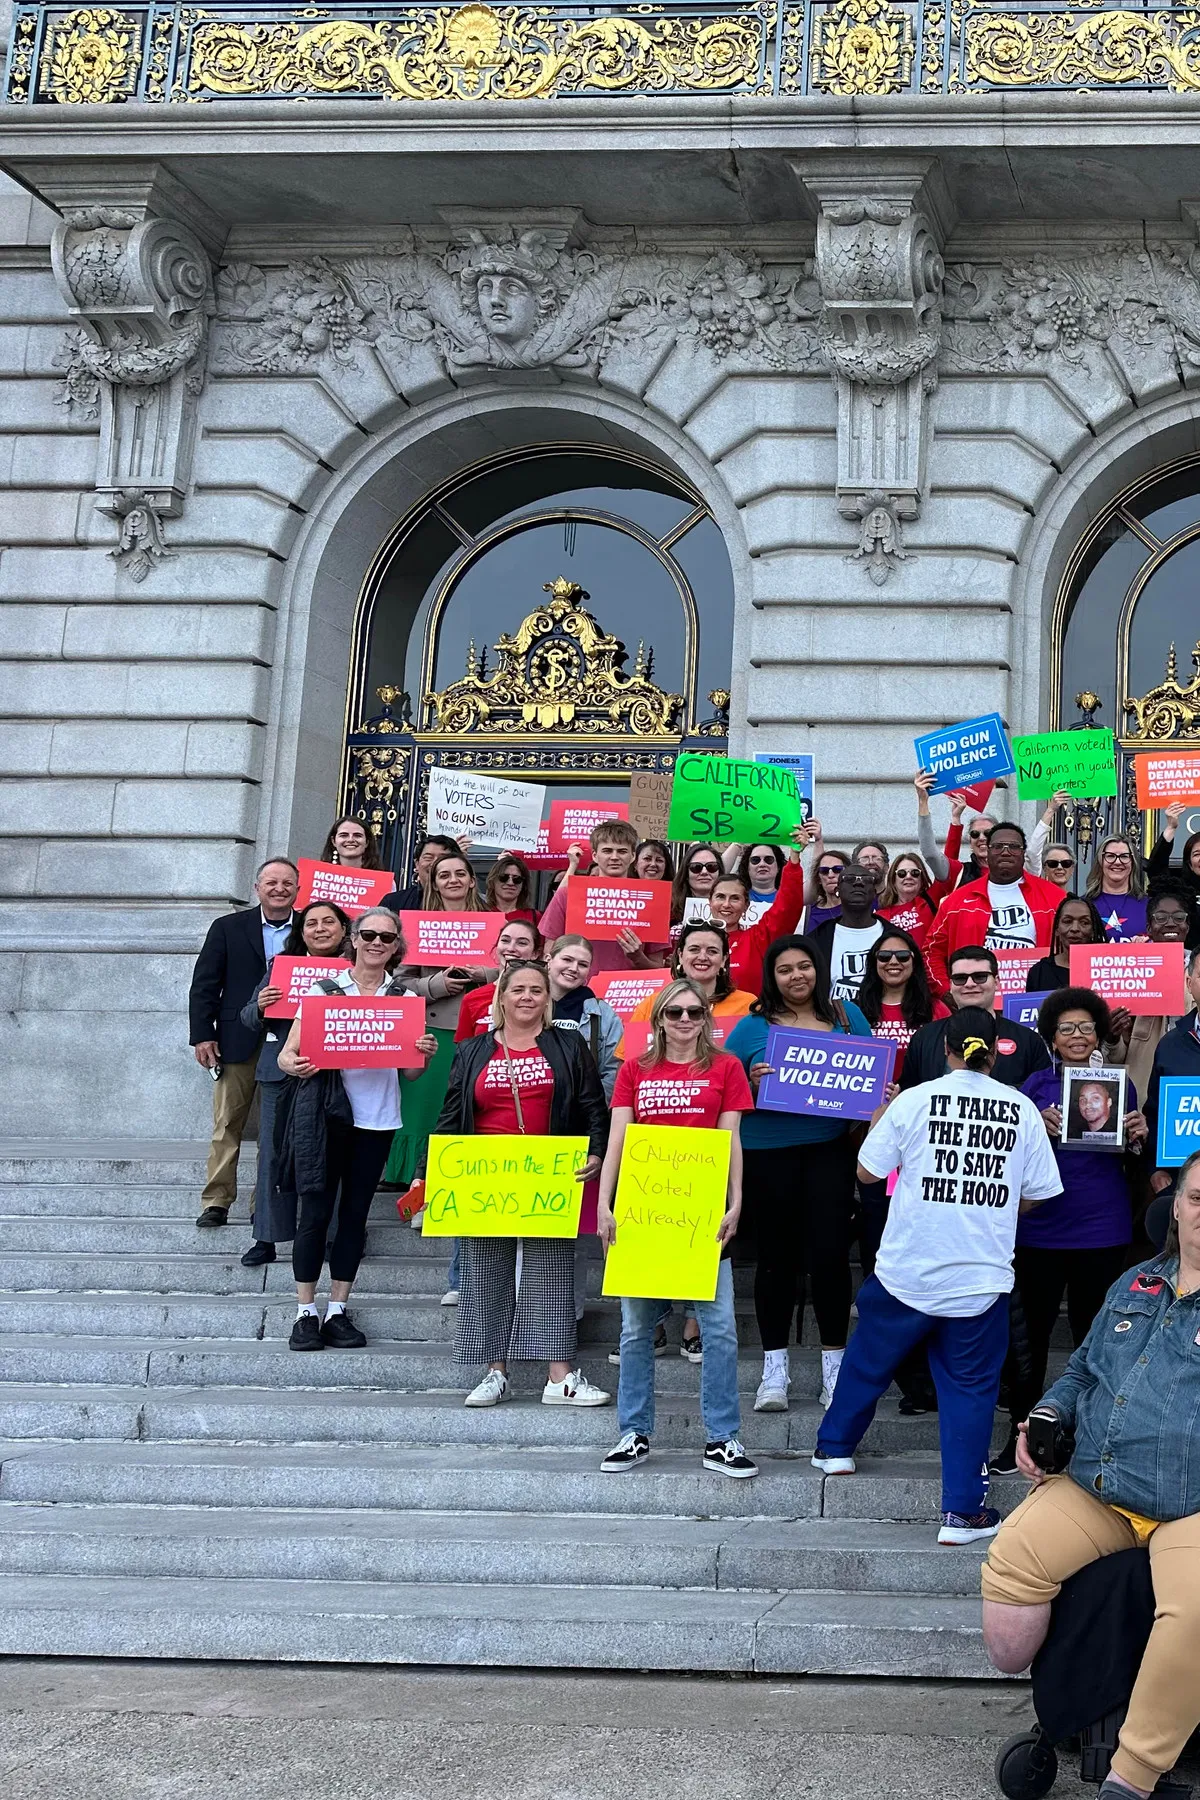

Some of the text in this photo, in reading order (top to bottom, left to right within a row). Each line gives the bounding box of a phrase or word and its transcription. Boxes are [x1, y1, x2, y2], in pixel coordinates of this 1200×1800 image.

[929, 729, 990, 759] END GUN
[1017, 735, 1111, 758] California voted!
[929, 744, 998, 774] VIOLENCE
[1147, 759, 1185, 770] MOMS
[680, 758, 801, 800] CALIFORNIA
[1019, 761, 1042, 783] NO
[1044, 764, 1070, 782] guns
[1074, 762, 1085, 772] in
[1148, 769, 1200, 781] DEMAND
[463, 779, 477, 791] the
[480, 781, 495, 793] will
[498, 784, 509, 796] of
[512, 787, 530, 798] our
[1050, 779, 1087, 793] centers
[1148, 779, 1195, 791] ACTION
[444, 787, 495, 811] VOTERS
[720, 791, 757, 811] FOR
[435, 807, 449, 821] NO
[451, 811, 487, 828] GUNS
[489, 818, 499, 829] in
[563, 809, 599, 820] MOMS
[690, 808, 783, 838] SB 2
[313, 870, 354, 886] MOMS
[311, 880, 368, 897] DEMAND
[587, 888, 630, 899] MOMS
[310, 890, 359, 905] ACTION
[586, 898, 646, 911] DEMAND
[585, 909, 638, 920] ACTION
[991, 907, 1026, 927] UP
[419, 920, 462, 930] MOMS
[419, 930, 479, 940] DEMAND
[418, 939, 471, 949] ACTION
[1090, 956, 1137, 967] MOMS
[292, 966, 337, 980] MOMS
[1090, 967, 1156, 979] DEMAND
[609, 979, 645, 989] MOMS
[1090, 979, 1147, 991] ACTION
[604, 989, 655, 999] DEMAND
[324, 1009, 376, 1020] MOMS
[324, 1020, 395, 1032] DEMAND
[323, 1032, 386, 1044] ACTION
[783, 1046, 876, 1072] END GUN
[638, 1079, 685, 1089] MOMS
[778, 1067, 877, 1093] VIOLENCE
[638, 1087, 701, 1100] DEMAND
[638, 1096, 692, 1111] ACTION
[818, 1099, 844, 1109] BRADY
[929, 1095, 1021, 1126] IT TAKES
[928, 1121, 1017, 1152] THE HOOD
[438, 1141, 544, 1180] Guns in the
[934, 1149, 1006, 1179] TO SAVE
[630, 1174, 692, 1197] Voted
[921, 1177, 1009, 1208] THE HOOD
[430, 1188, 573, 1222] CA SAYS NO!
[618, 1206, 712, 1249] Already!
